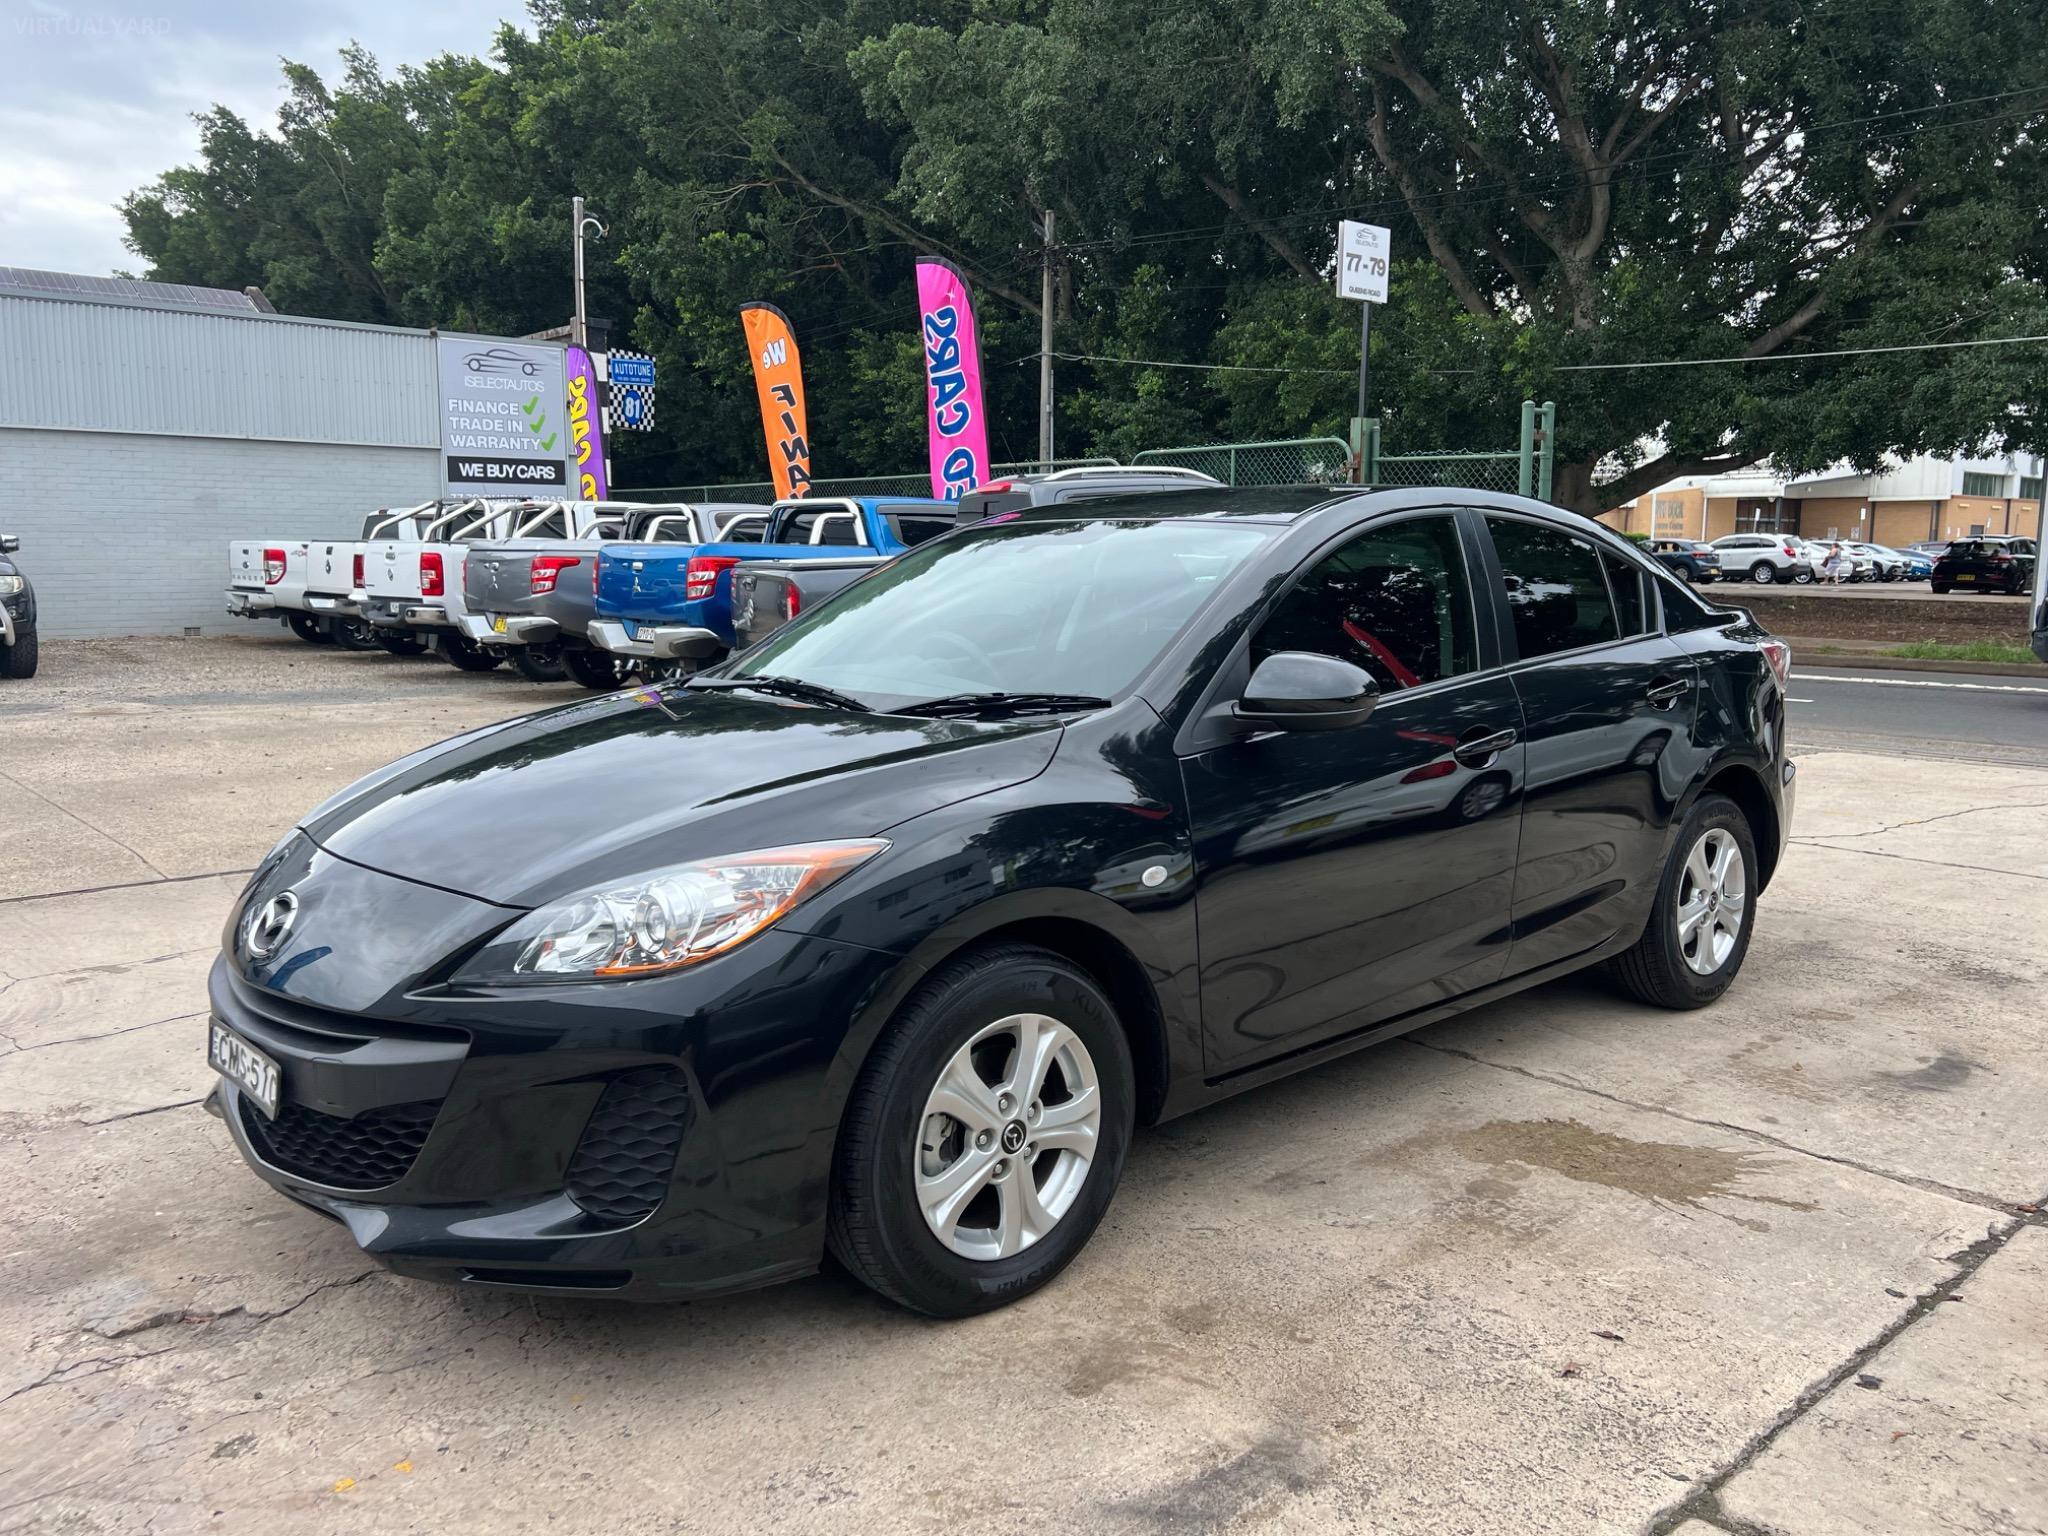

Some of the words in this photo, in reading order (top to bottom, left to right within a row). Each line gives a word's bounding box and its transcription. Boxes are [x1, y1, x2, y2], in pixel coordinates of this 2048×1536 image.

[614, 362, 652, 377] AUTOTUNE
[448, 398, 519, 415] FINANCE
[625, 396, 641, 419] 81
[449, 417, 505, 432] TRADE
[507, 420, 523, 433] IN
[450, 434, 541, 450] WARRANTY
[458, 462, 486, 478] WE
[486, 462, 517, 478] BUY
[516, 464, 556, 480] CARS
